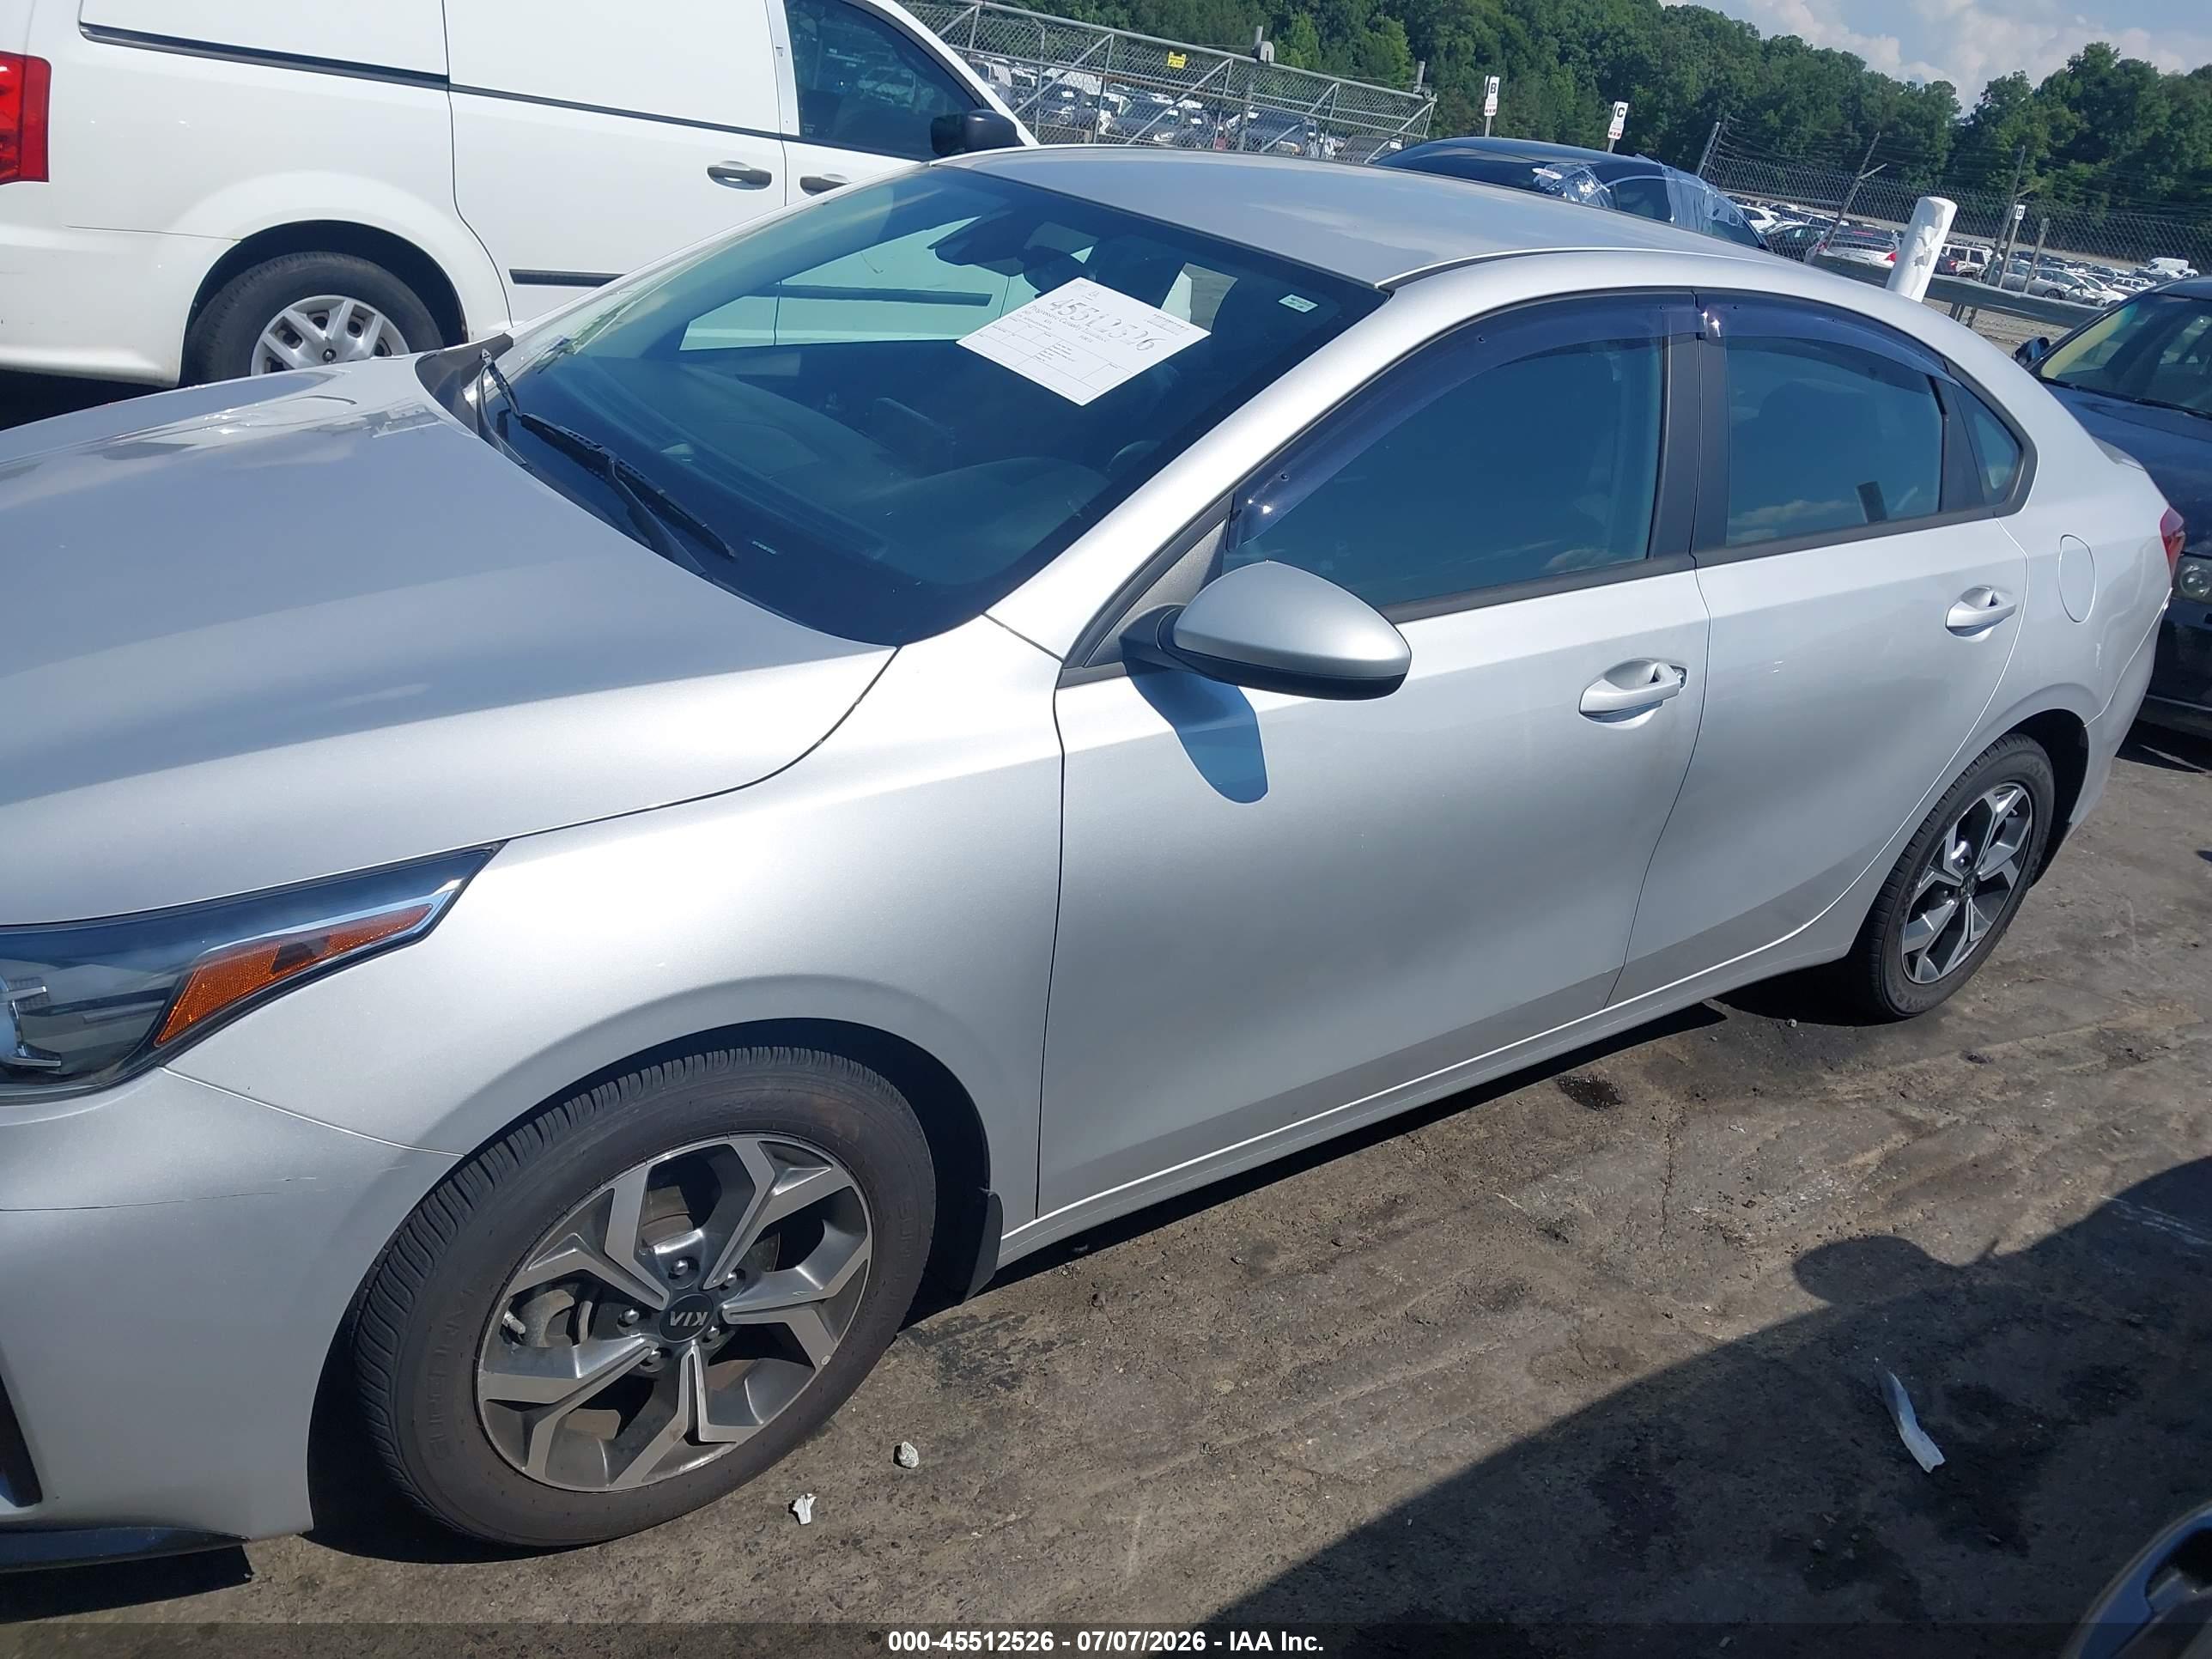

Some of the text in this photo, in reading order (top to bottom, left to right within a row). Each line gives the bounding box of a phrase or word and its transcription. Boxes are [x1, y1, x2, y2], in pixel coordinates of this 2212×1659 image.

[1490, 82, 1497, 94] B
[1617, 107, 1626, 118] C
[670, 1311, 708, 1327] KIA
